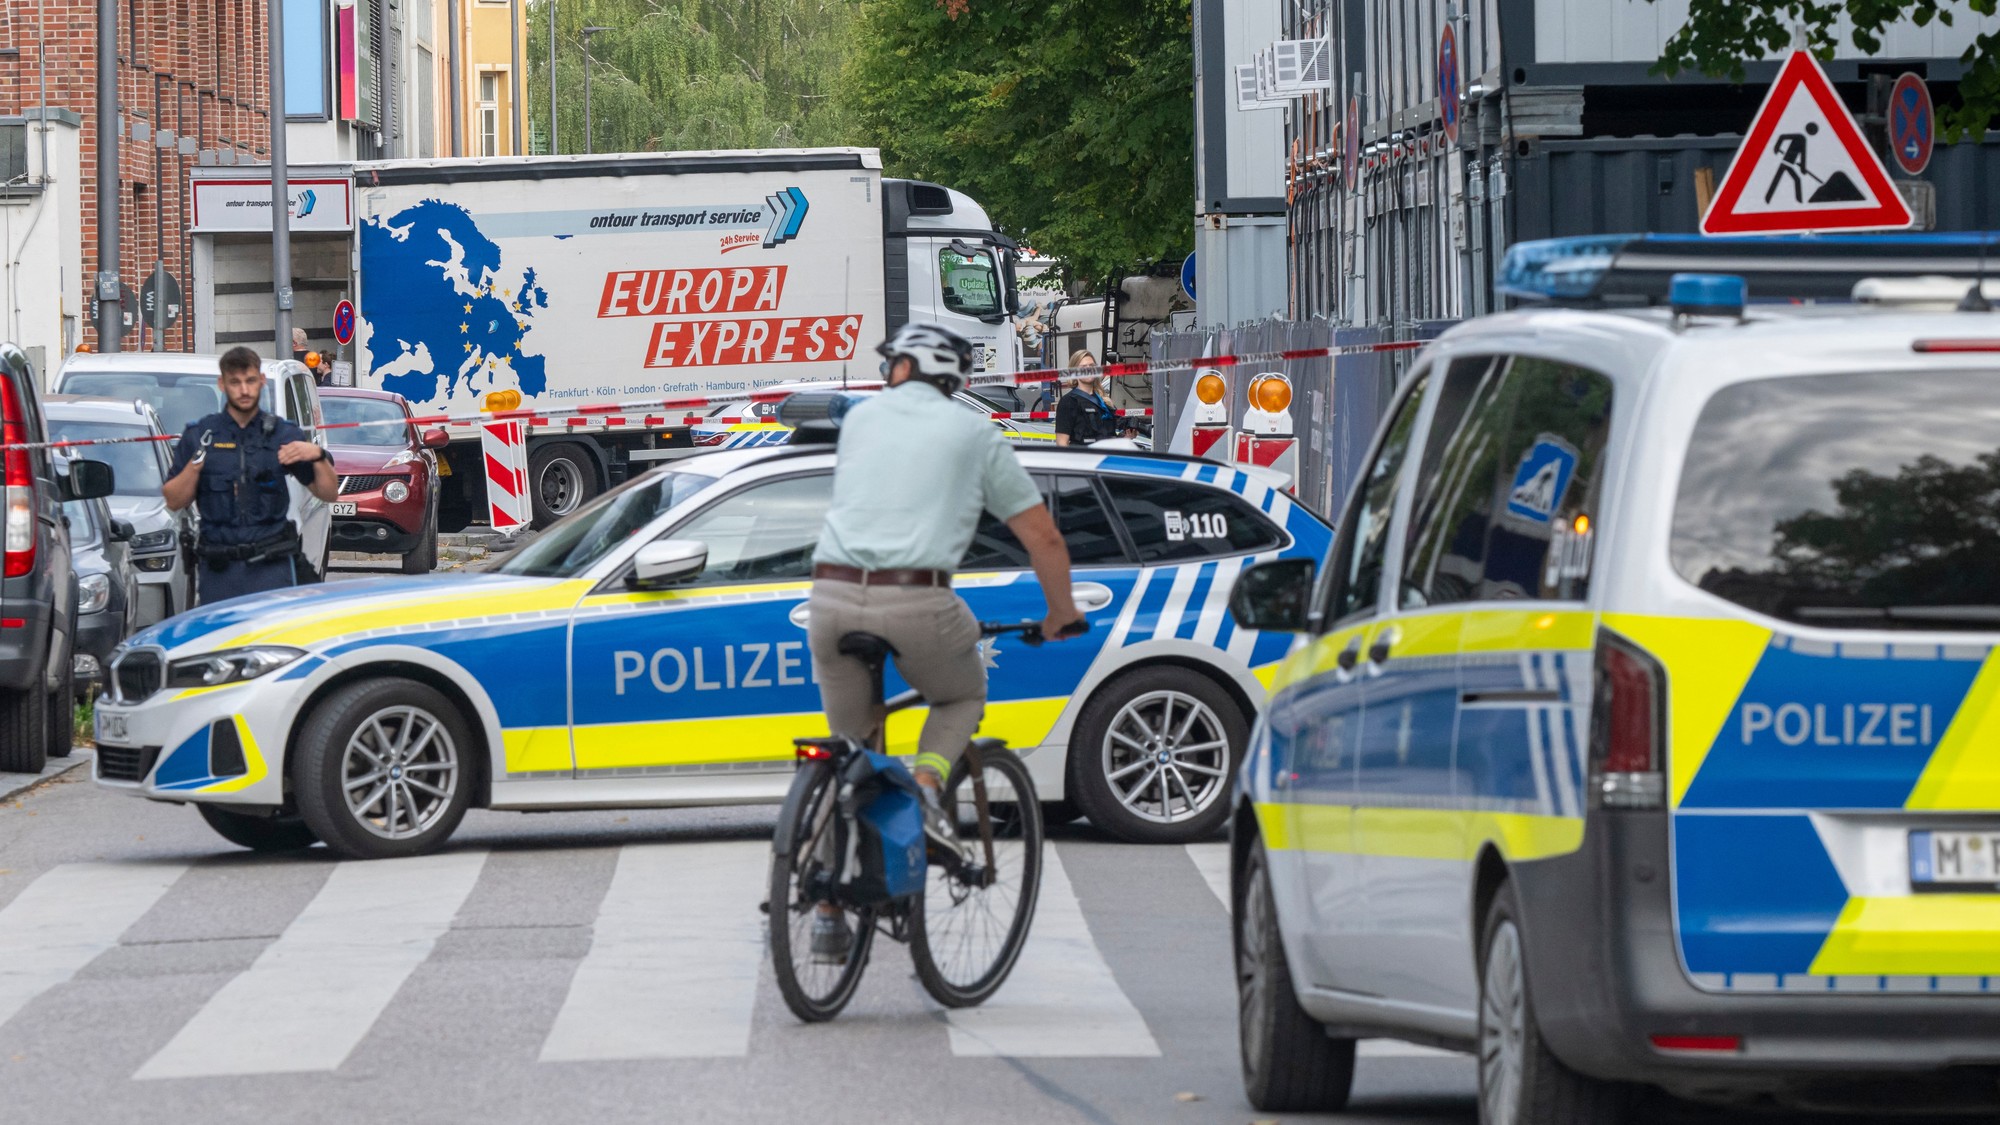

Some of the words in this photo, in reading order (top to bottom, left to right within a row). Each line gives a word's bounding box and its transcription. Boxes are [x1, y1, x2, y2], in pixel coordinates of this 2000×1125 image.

[246, 199, 273, 208] transpor
[590, 212, 638, 228] ontour
[640, 210, 706, 228] transport
[708, 208, 761, 225] service
[720, 235, 733, 247] 24h
[734, 232, 760, 243] Service
[601, 267, 778, 316] EUROPA
[648, 317, 859, 367] EXPRESS
[549, 387, 589, 399] Frankfurt
[596, 386, 616, 396] Köln
[623, 384, 656, 395] London
[663, 382, 699, 393] Grefrath
[705, 380, 746, 391] Hamburg
[333, 504, 353, 515] GYZ
[1189, 513, 1228, 538] 110
[1741, 702, 1932, 746] POLIZEI
